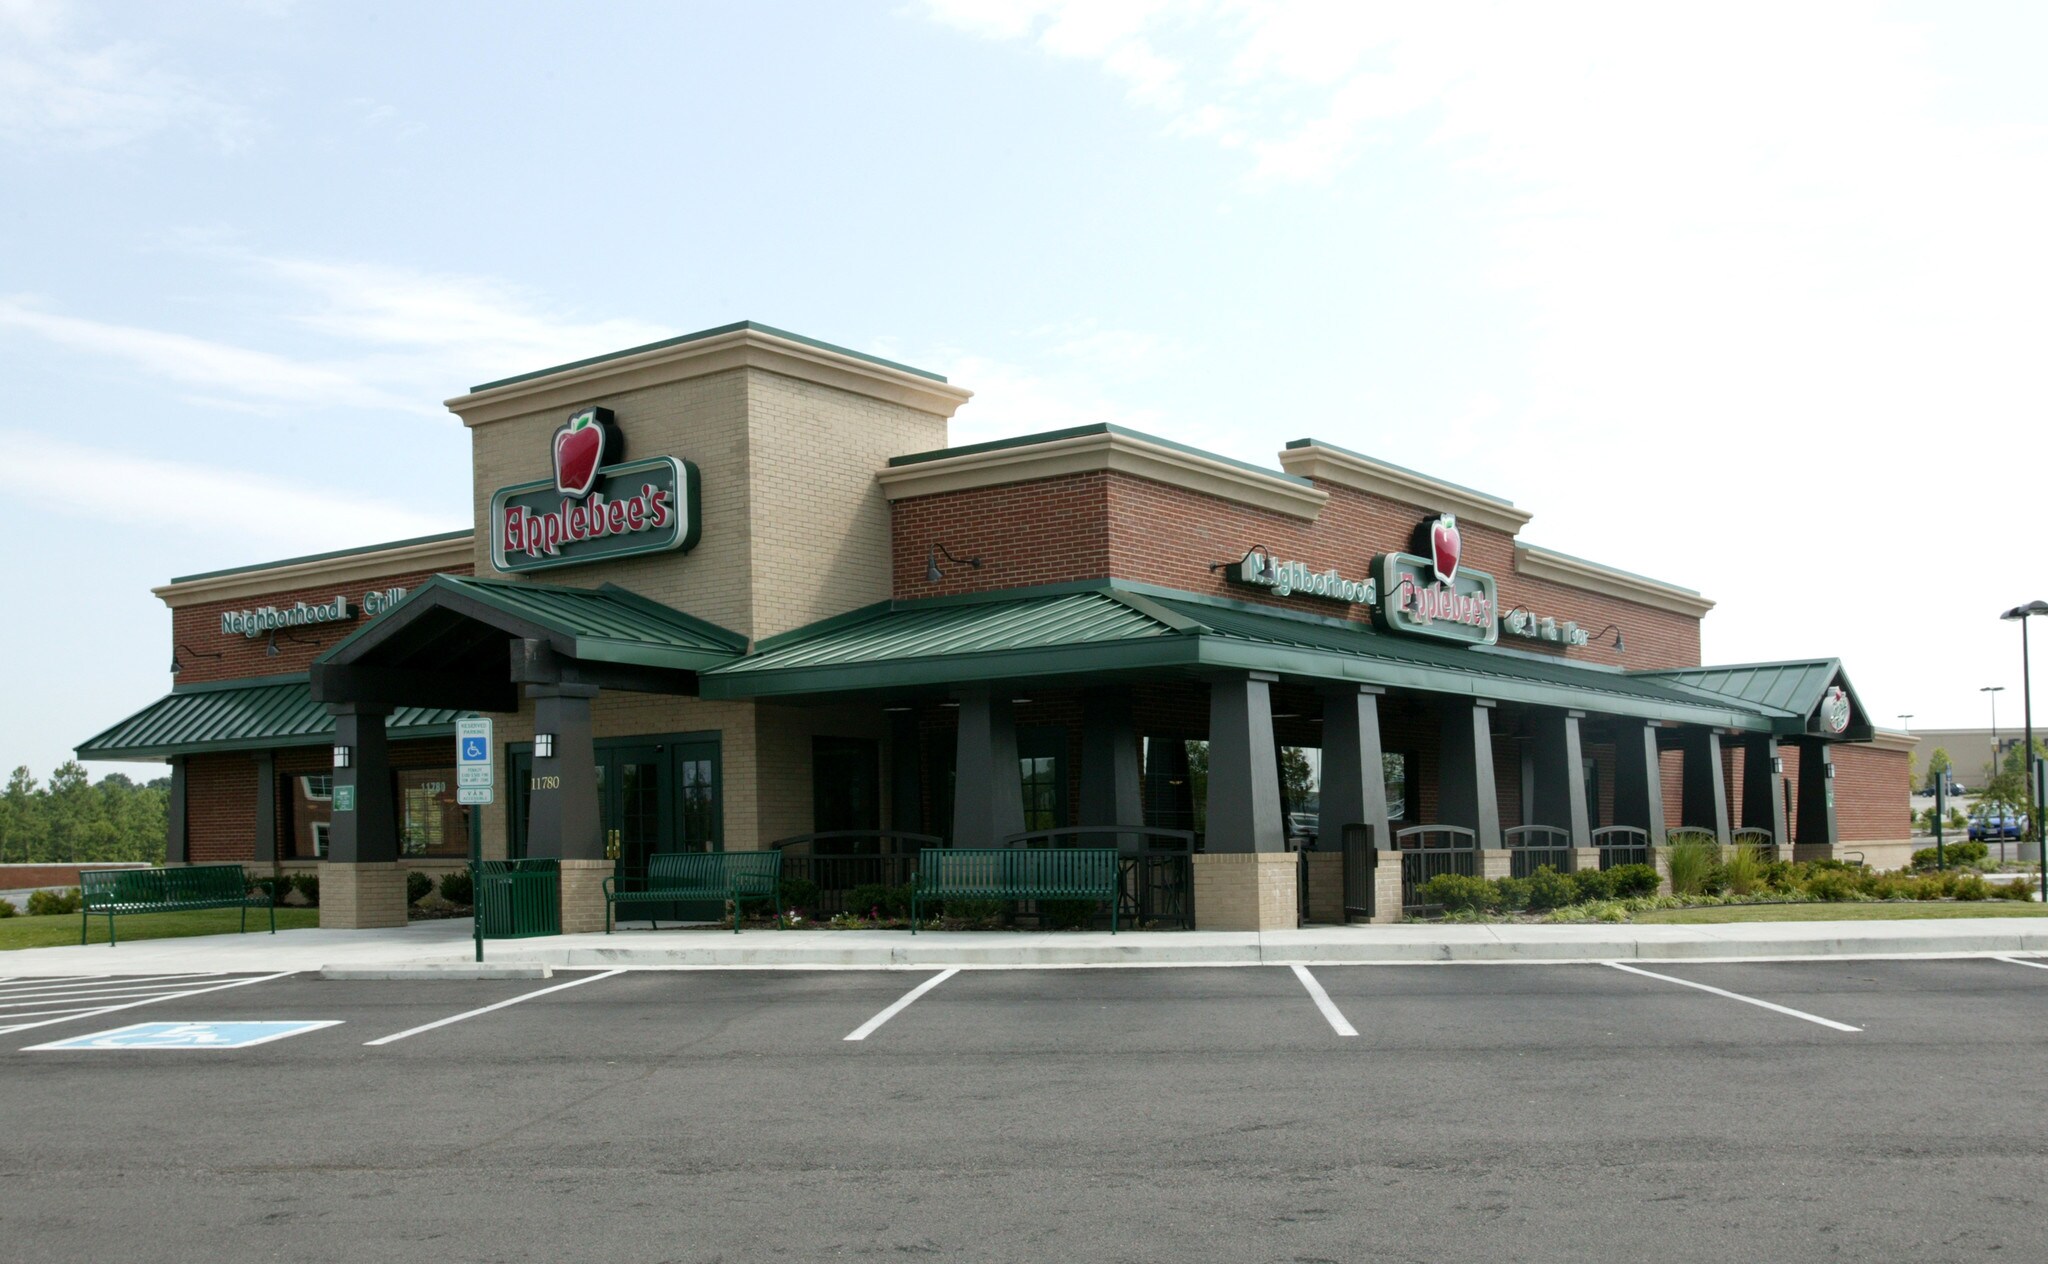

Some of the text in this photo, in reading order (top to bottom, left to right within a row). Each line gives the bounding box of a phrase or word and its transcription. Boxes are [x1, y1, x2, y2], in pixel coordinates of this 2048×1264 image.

[504, 484, 672, 558] Applebee's
[1245, 552, 1376, 605] Nighborhood
[222, 596, 346, 638] Neighborhood
[421, 782, 446, 792] 11780
[531, 776, 560, 790] 11780
